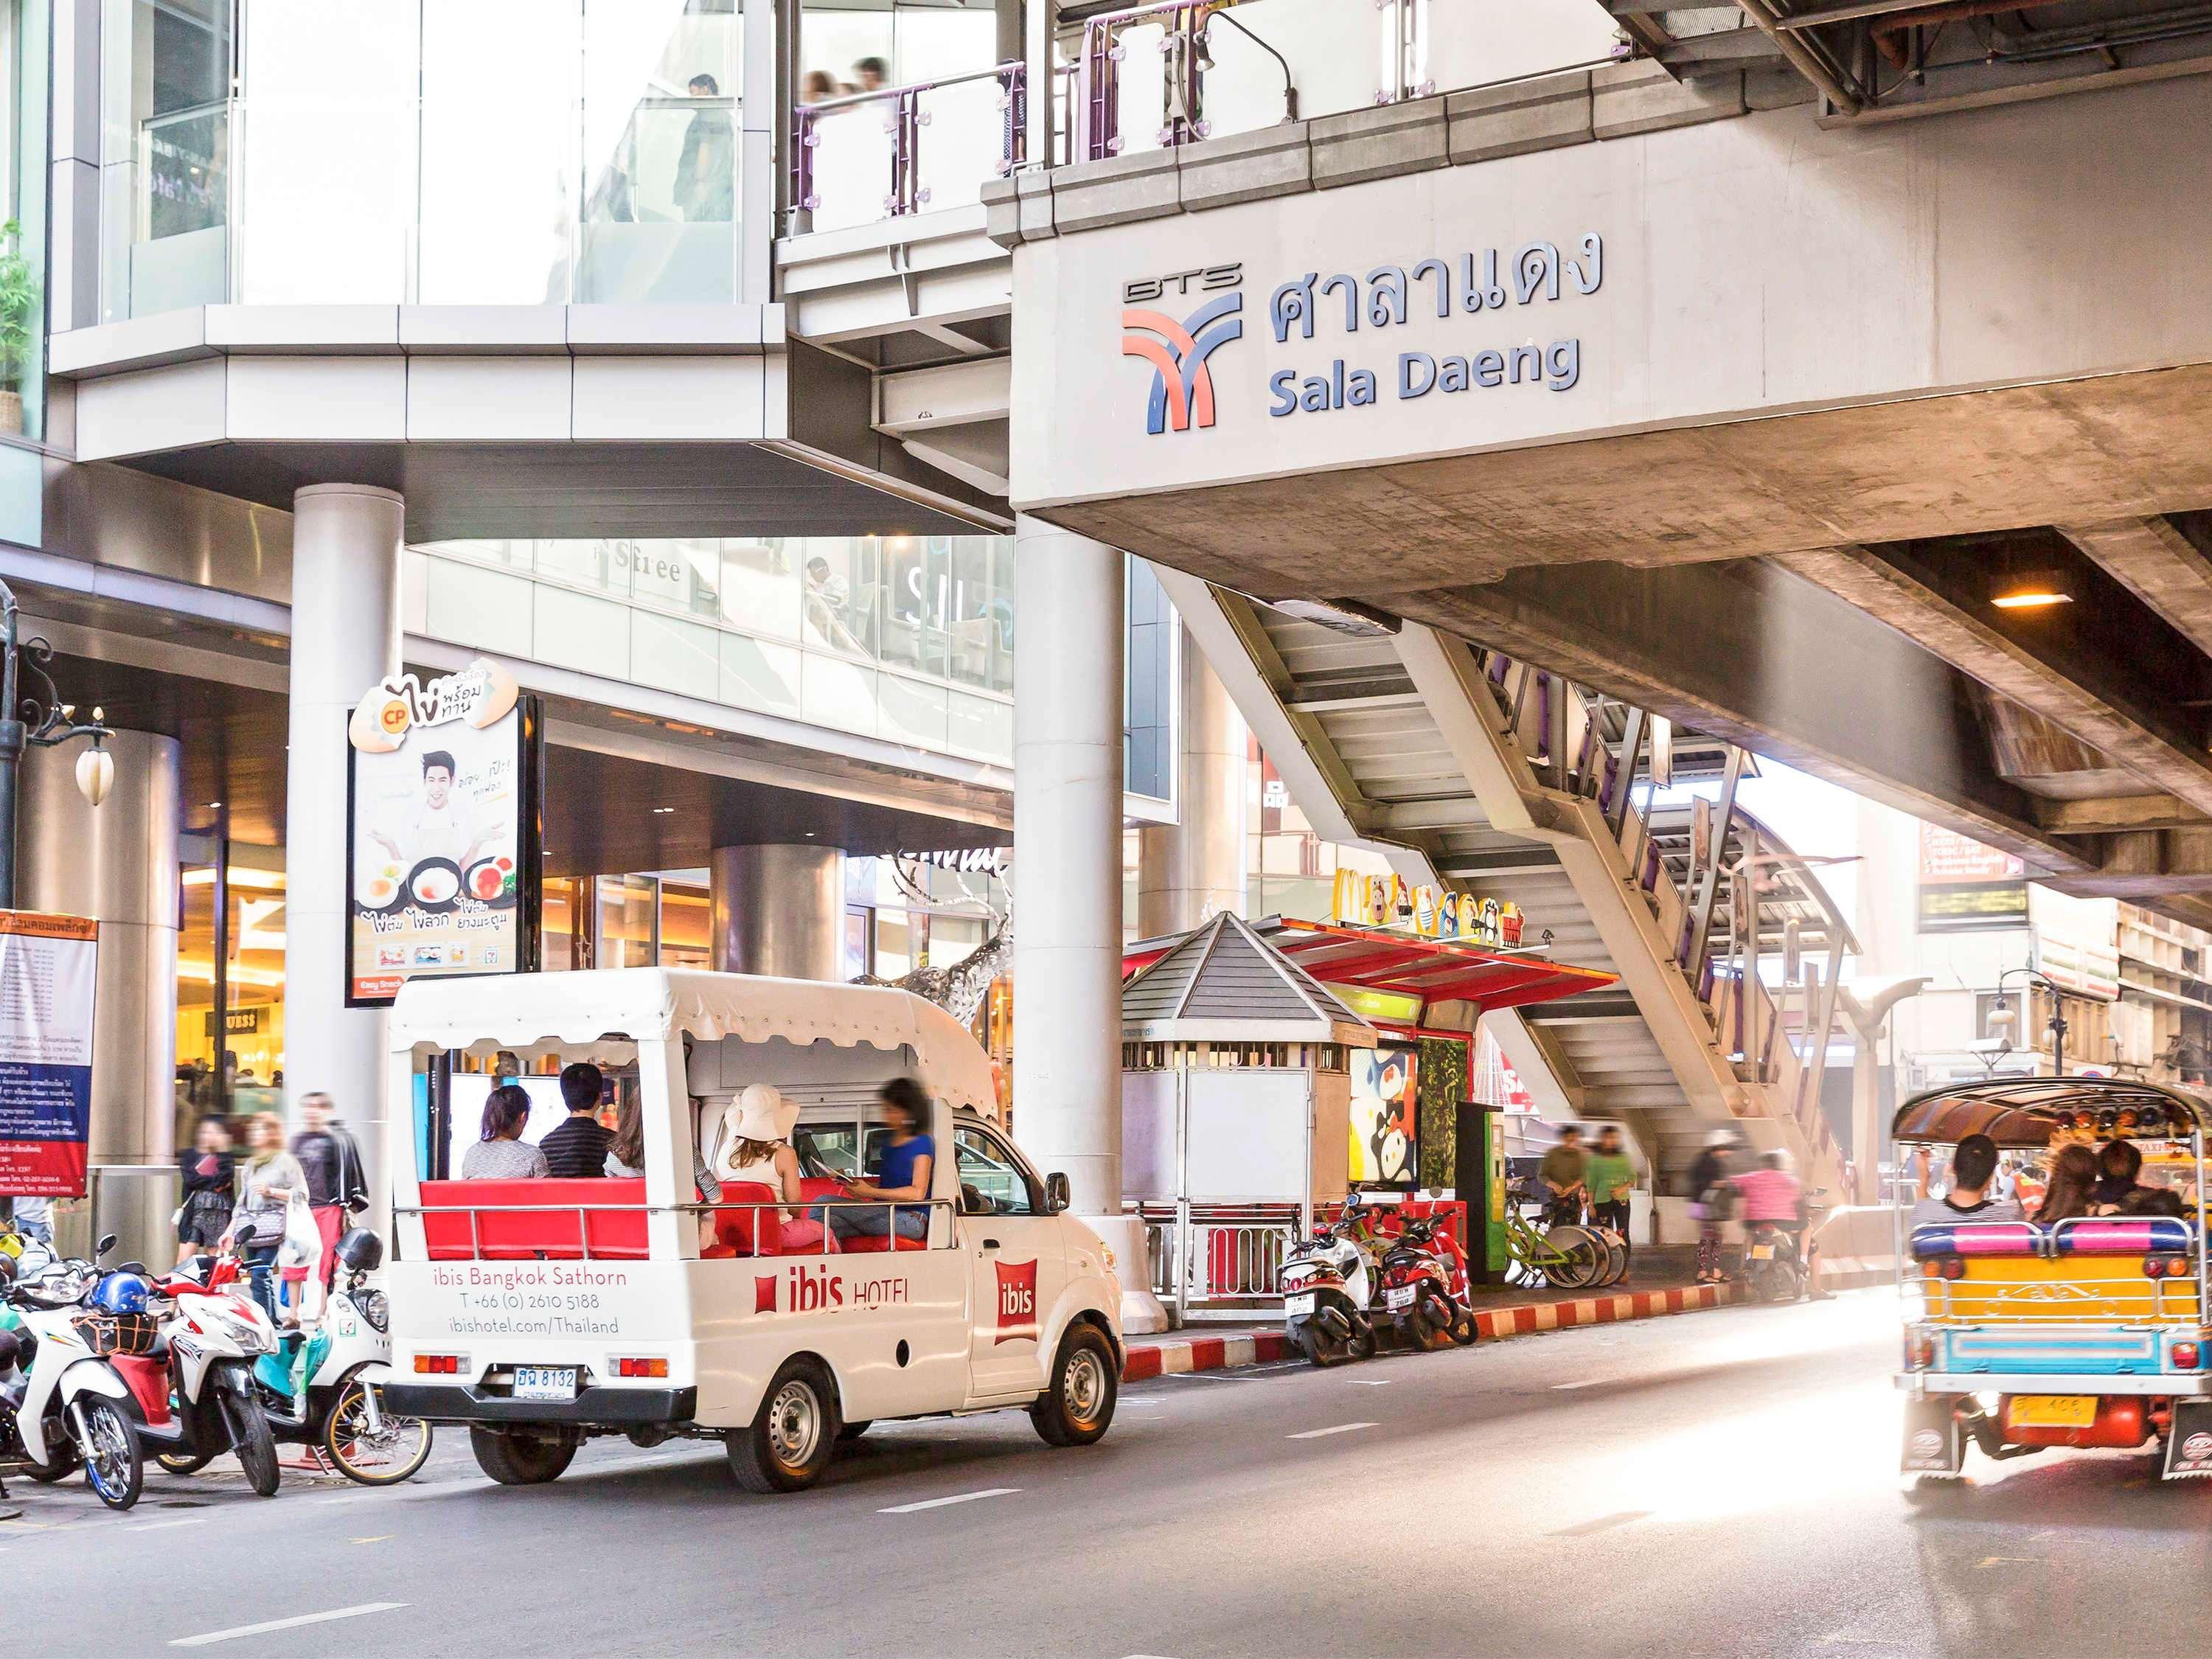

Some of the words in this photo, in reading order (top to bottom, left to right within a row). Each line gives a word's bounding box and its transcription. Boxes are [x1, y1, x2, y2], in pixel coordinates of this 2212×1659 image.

[1123, 262, 1243, 302] BTS
[1269, 232, 1602, 342] ศาลาแดง
[1269, 359, 1376, 417] Sala
[1399, 338, 1579, 400] Daeng
[385, 682, 439, 723] ไข่
[443, 684, 481, 703] พร้อม
[384, 709, 406, 724] CP
[442, 700, 471, 717] ทาน
[364, 912, 403, 933] ไข่ต้ม
[406, 907, 449, 928] ไข่ลวก
[457, 914, 507, 931] ยางมะตูม
[226, 1014, 256, 1029] UESS
[434, 1267, 463, 1285] ibis
[470, 1267, 547, 1290] Bangkok
[553, 1267, 627, 1285] Sathorn
[790, 1264, 843, 1315] ibis
[854, 1278, 911, 1310] HOTEL
[1003, 1281, 1033, 1315] ibis
[460, 1293, 468, 1308] T
[474, 1295, 498, 1309] +66
[503, 1293, 524, 1310] (0)
[529, 1295, 561, 1309] 2610
[567, 1295, 599, 1310] 5188
[449, 1316, 619, 1335] ibishotel.com/Thailand
[542, 1371, 574, 1387] 8132
